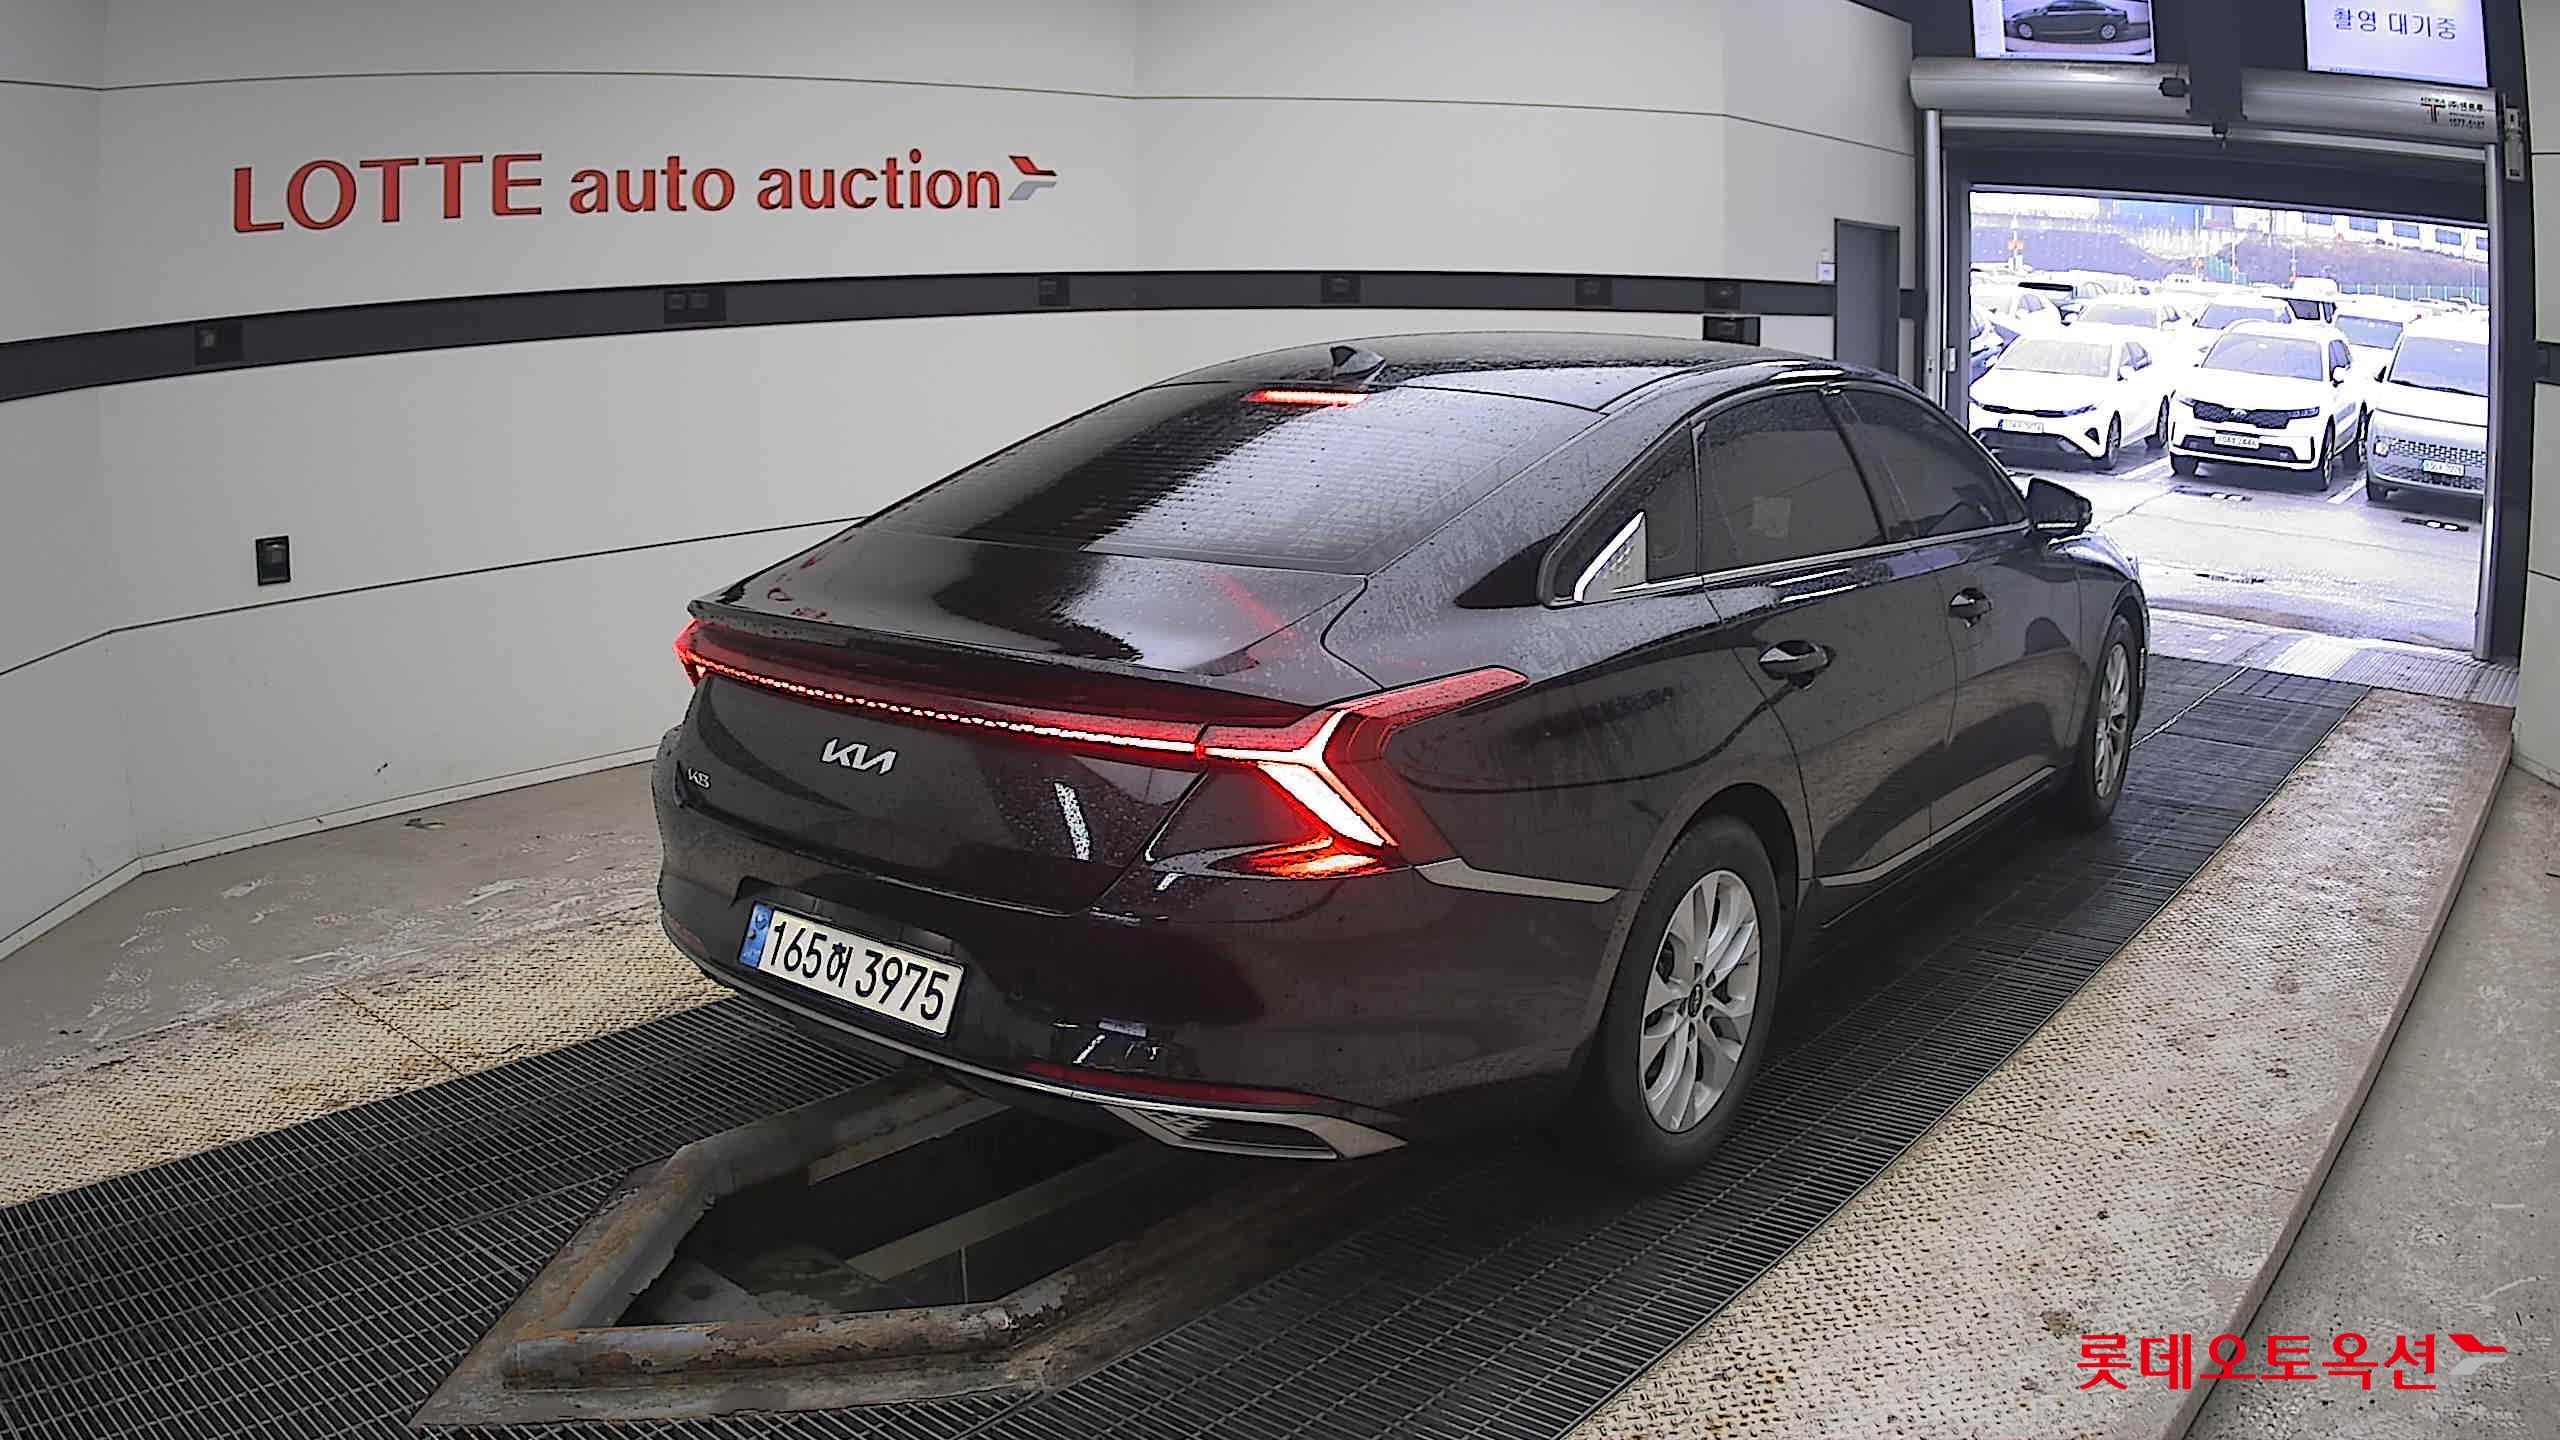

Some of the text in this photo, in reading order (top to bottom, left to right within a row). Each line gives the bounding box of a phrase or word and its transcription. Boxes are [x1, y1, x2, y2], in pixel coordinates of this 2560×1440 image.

[2388, 12, 2457, 40] 대기중
[233, 149, 1000, 233] LOTTE auto auction
[822, 738, 897, 776] KIA
